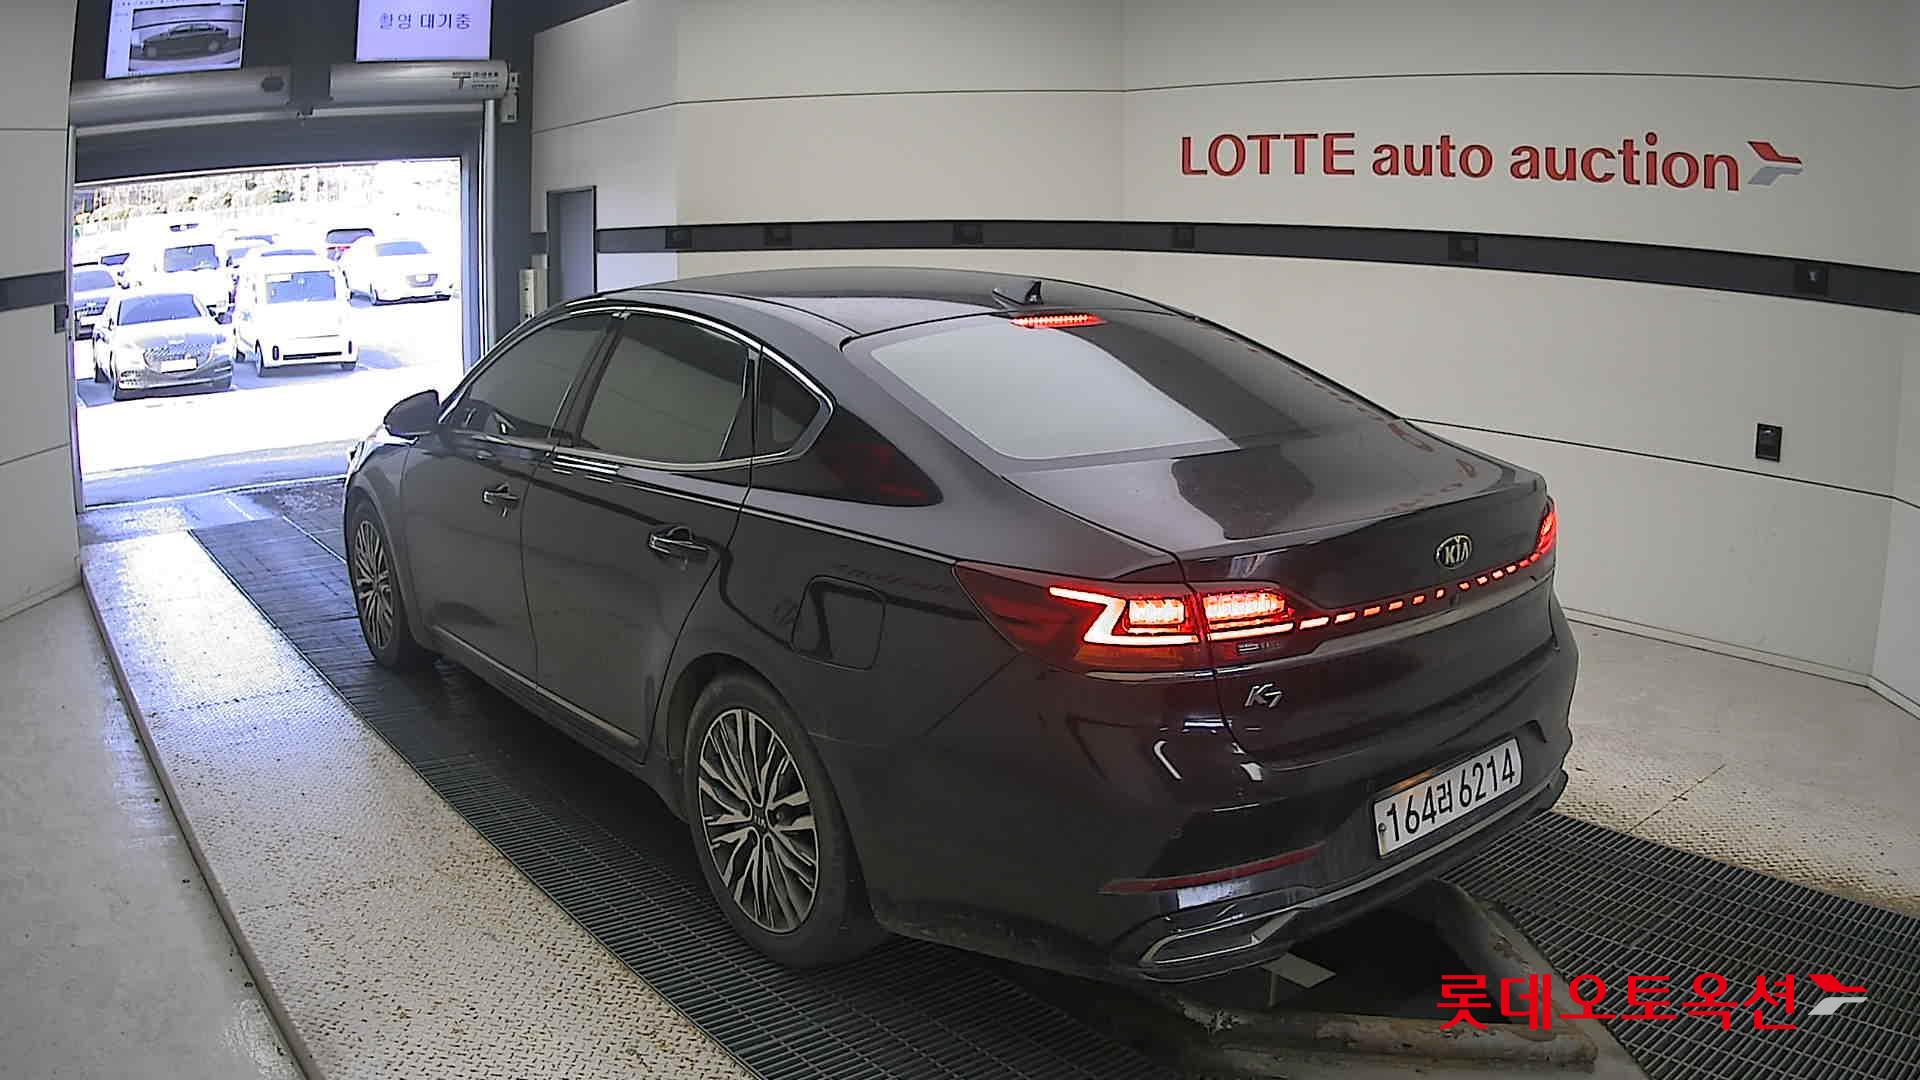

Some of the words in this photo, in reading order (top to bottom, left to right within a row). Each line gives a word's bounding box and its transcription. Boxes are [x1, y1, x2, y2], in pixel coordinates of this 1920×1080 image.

[420, 13, 472, 30] 대기중
[1183, 133, 1355, 176] LOTTE
[1373, 136, 1493, 177] auto
[1511, 133, 1739, 191] auction
[1244, 683, 1283, 708] K7
